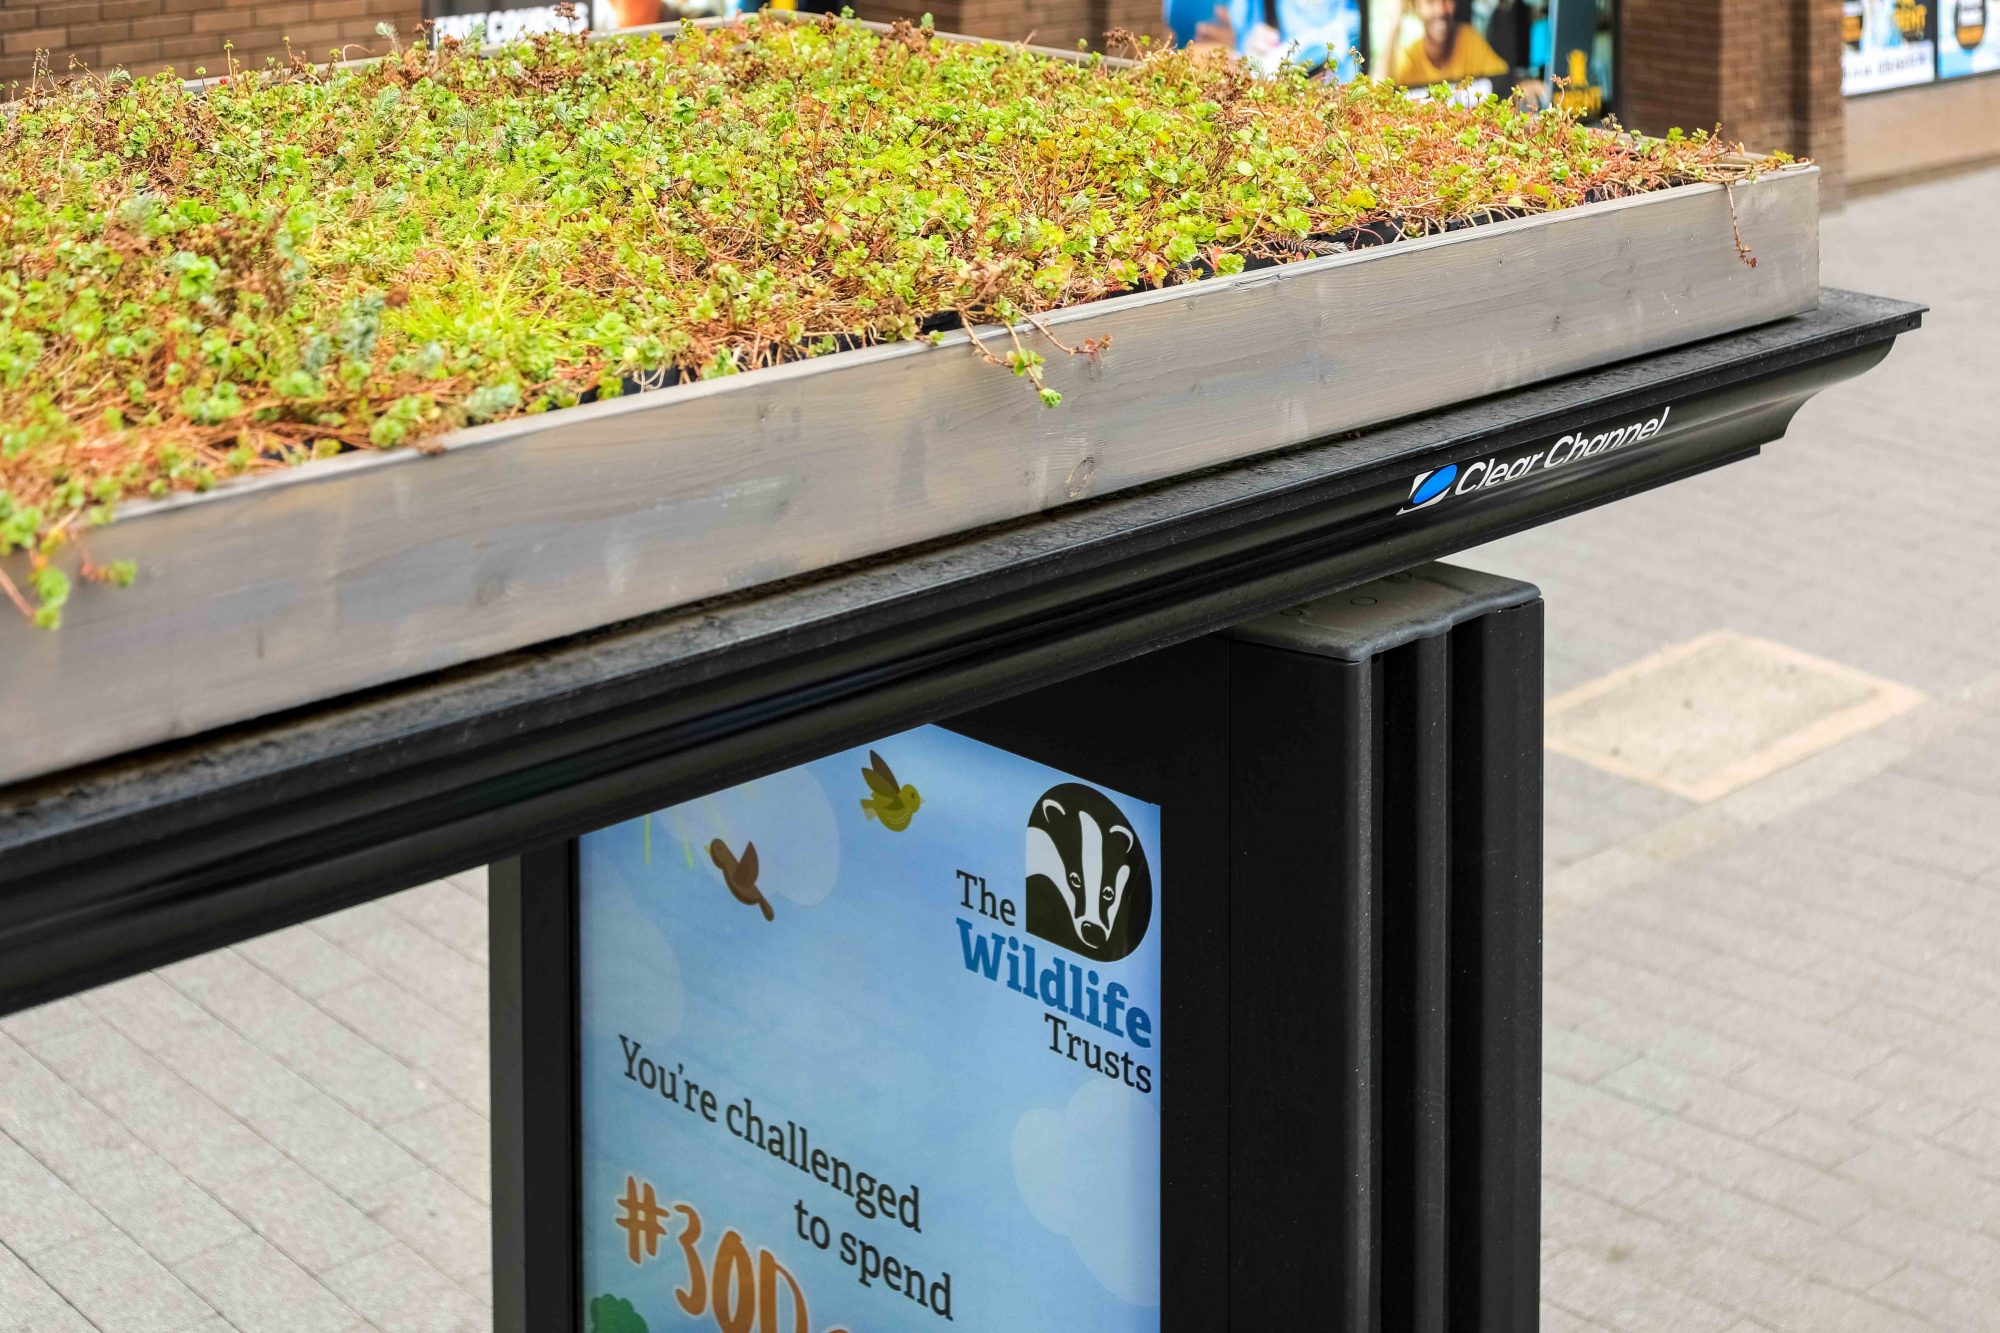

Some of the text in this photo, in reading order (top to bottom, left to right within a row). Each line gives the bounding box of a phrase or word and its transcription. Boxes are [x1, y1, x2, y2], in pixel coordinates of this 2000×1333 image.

[1455, 406, 1670, 495] Clear Channel
[956, 869, 1016, 926] The
[956, 917, 1152, 1048] Wildlife
[1044, 1013, 1152, 1094] Trusts
[618, 1034, 922, 1233] You're challenged
[614, 1175, 850, 1333] #30D
[794, 1199, 953, 1321] to spend
